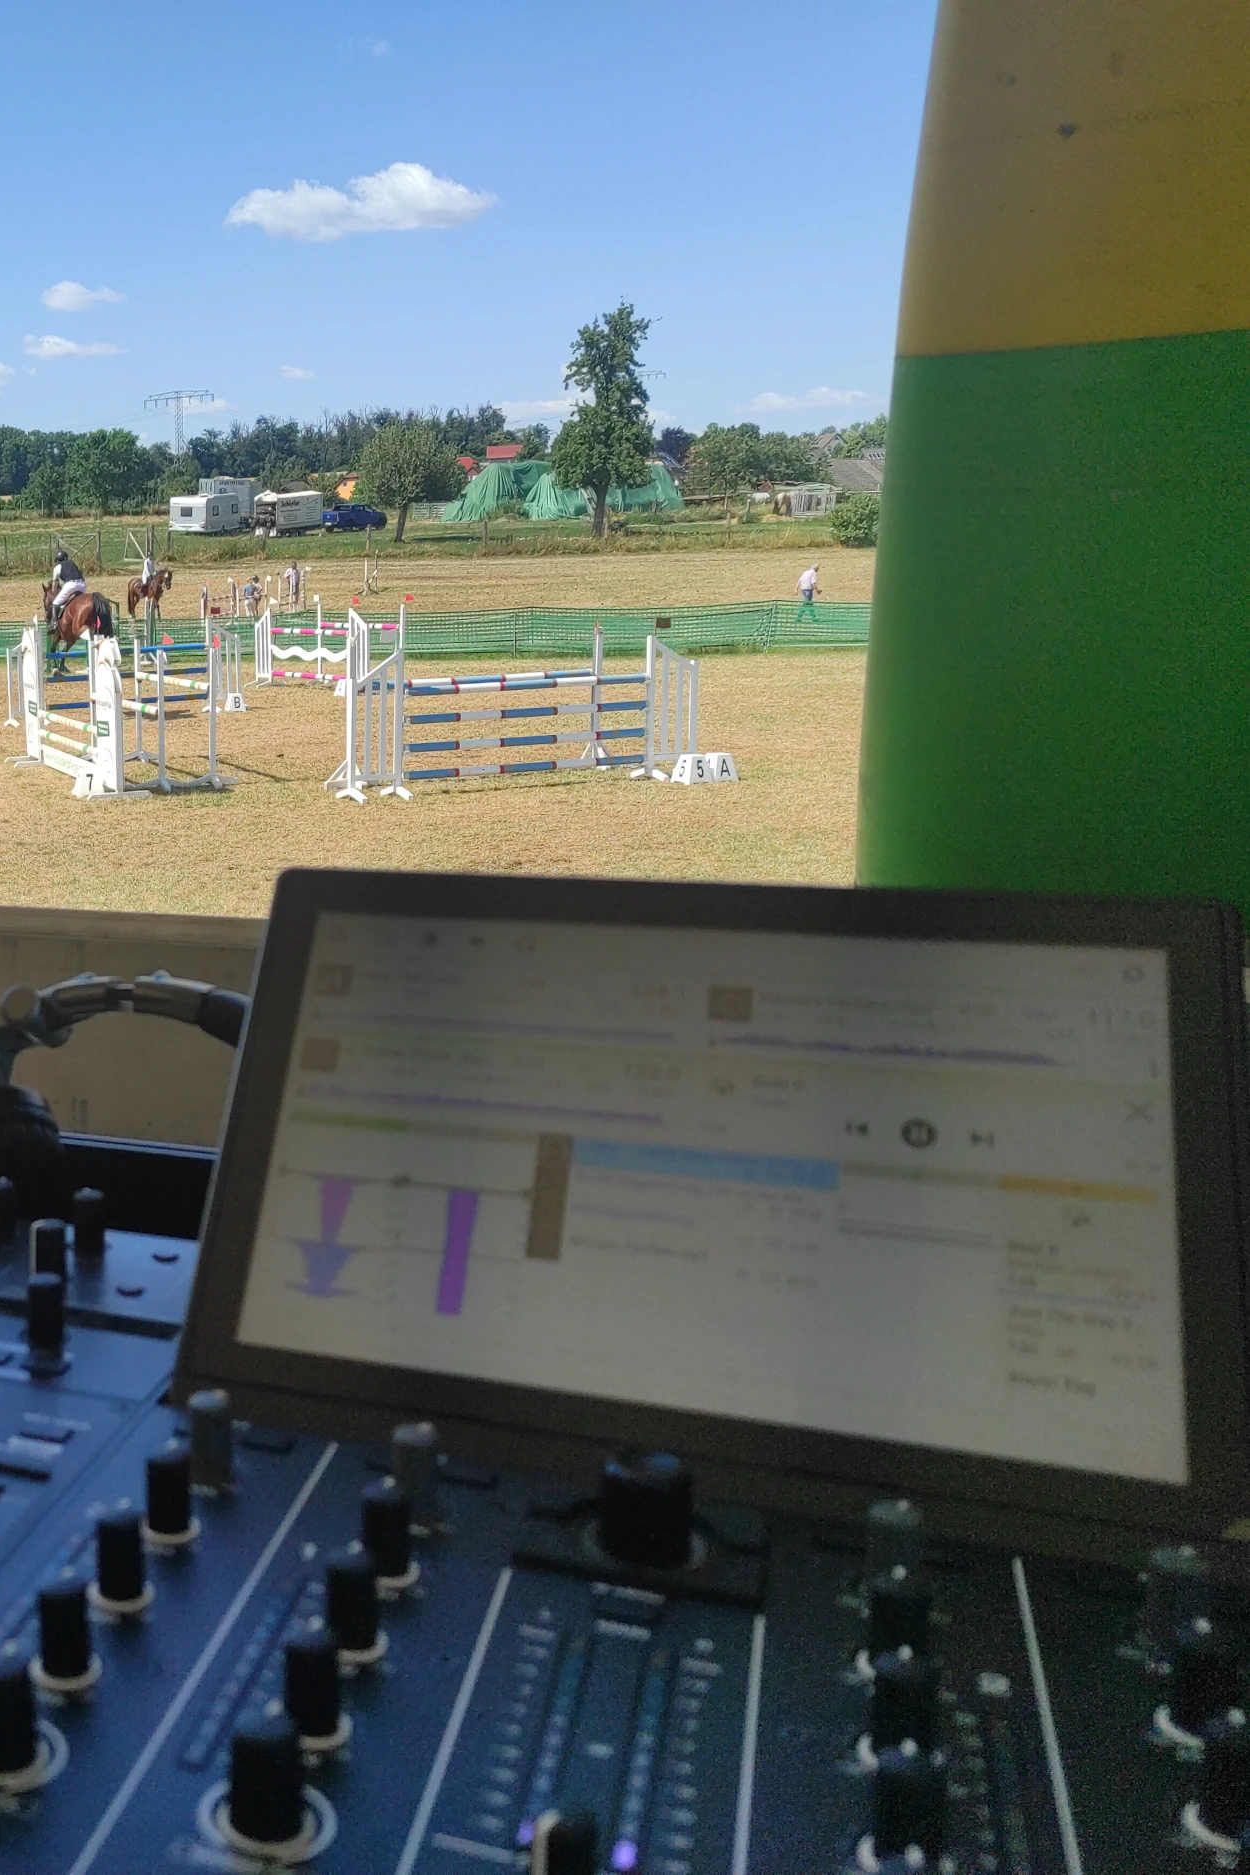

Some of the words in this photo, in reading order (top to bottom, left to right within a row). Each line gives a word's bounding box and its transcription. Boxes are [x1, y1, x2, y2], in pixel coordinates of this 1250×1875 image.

[234, 697, 240, 708] B
[696, 760, 704, 778] 5
[720, 759, 731, 777] A
[86, 774, 93, 791] 7
